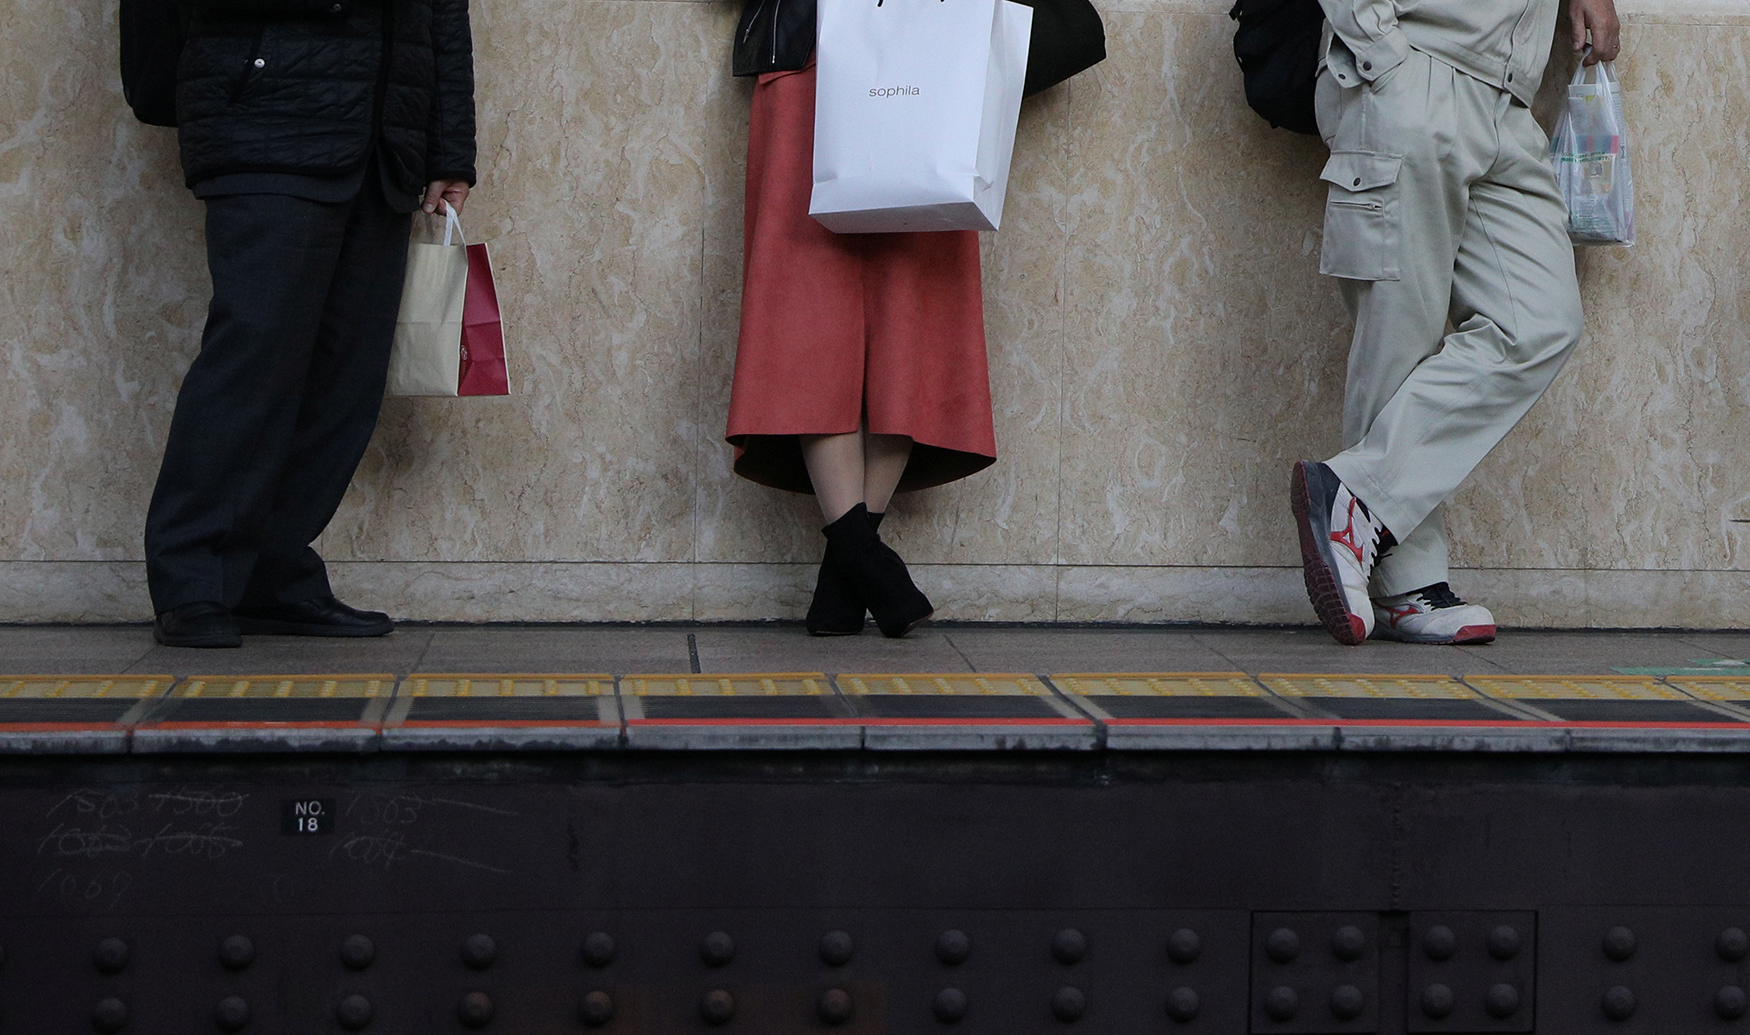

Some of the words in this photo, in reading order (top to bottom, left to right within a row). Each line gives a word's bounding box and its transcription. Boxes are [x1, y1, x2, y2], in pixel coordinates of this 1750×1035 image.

[869, 85, 920, 98] sophila
[294, 800, 326, 816] NO.
[297, 817, 318, 832] 18
